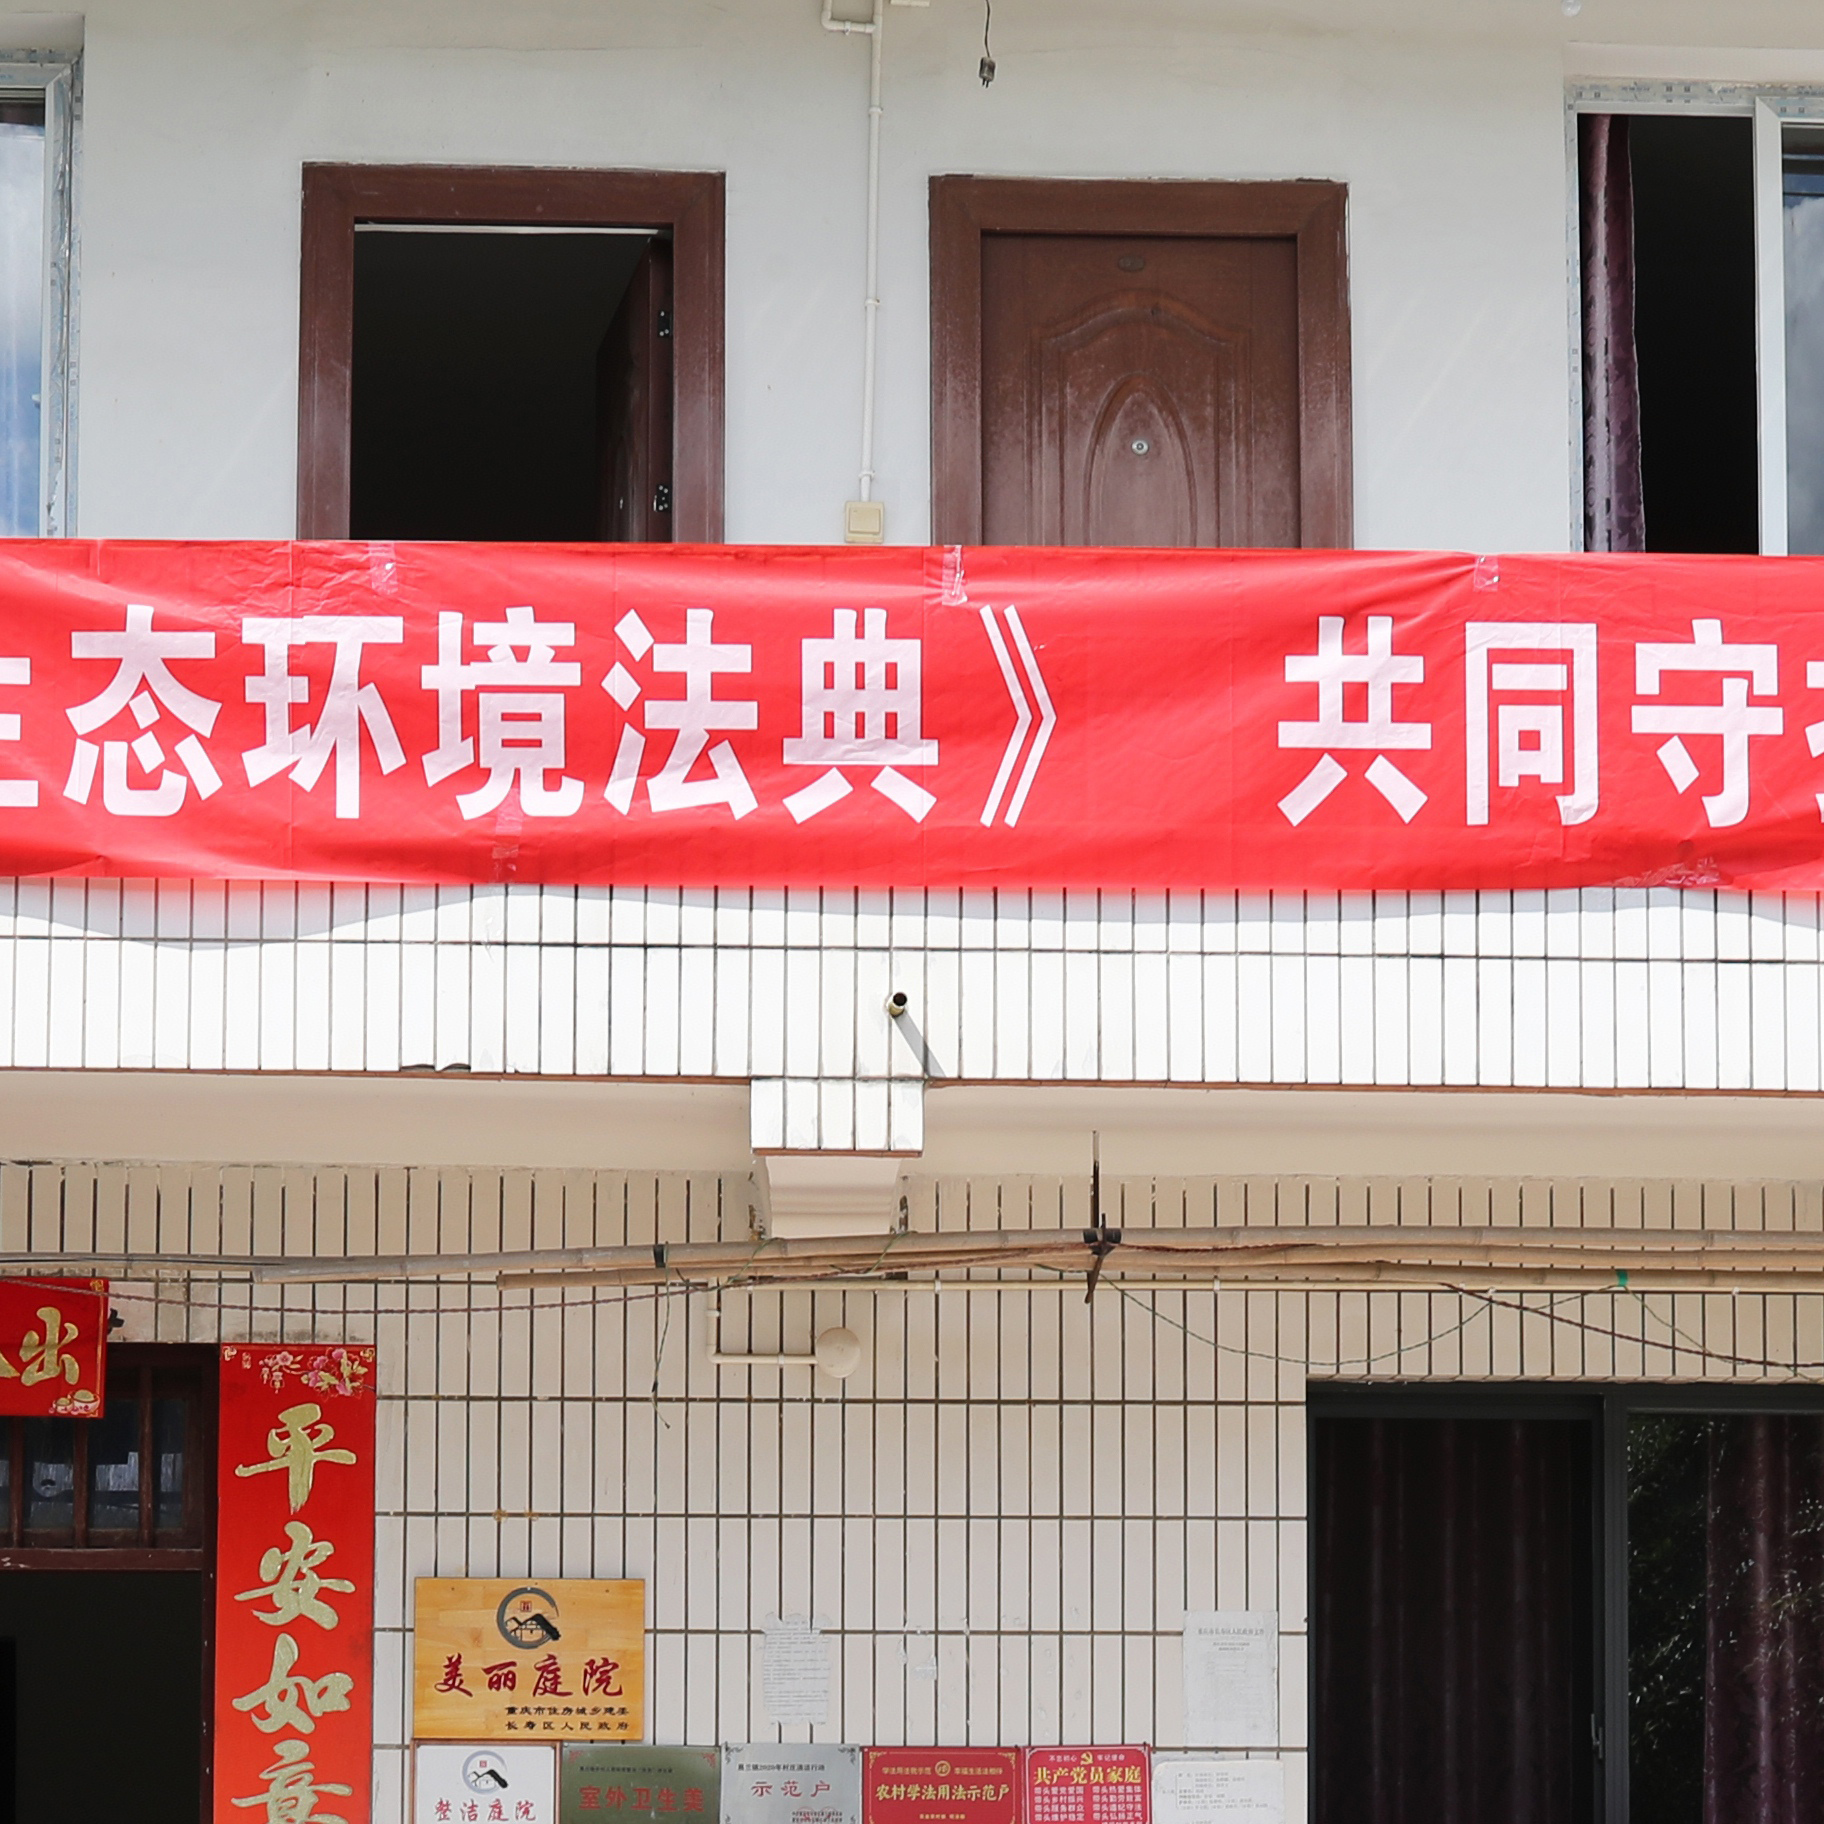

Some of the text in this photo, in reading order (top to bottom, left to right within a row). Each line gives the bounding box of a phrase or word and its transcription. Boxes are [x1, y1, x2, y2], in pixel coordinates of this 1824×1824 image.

[434, 1653, 623, 1698] 美丽庭院
[505, 1706, 630, 1716] 重庆市住房城乡建委
[505, 1721, 629, 1731] 长寿区人民政府
[1034, 1765, 1142, 1785] 共产党员家庭
[578, 1784, 705, 1813] 室外卫生美
[751, 1780, 831, 1798] 示范户
[876, 1783, 1010, 1802] 农村学法用法示范户
[434, 1797, 536, 1822] 整洁庭院
